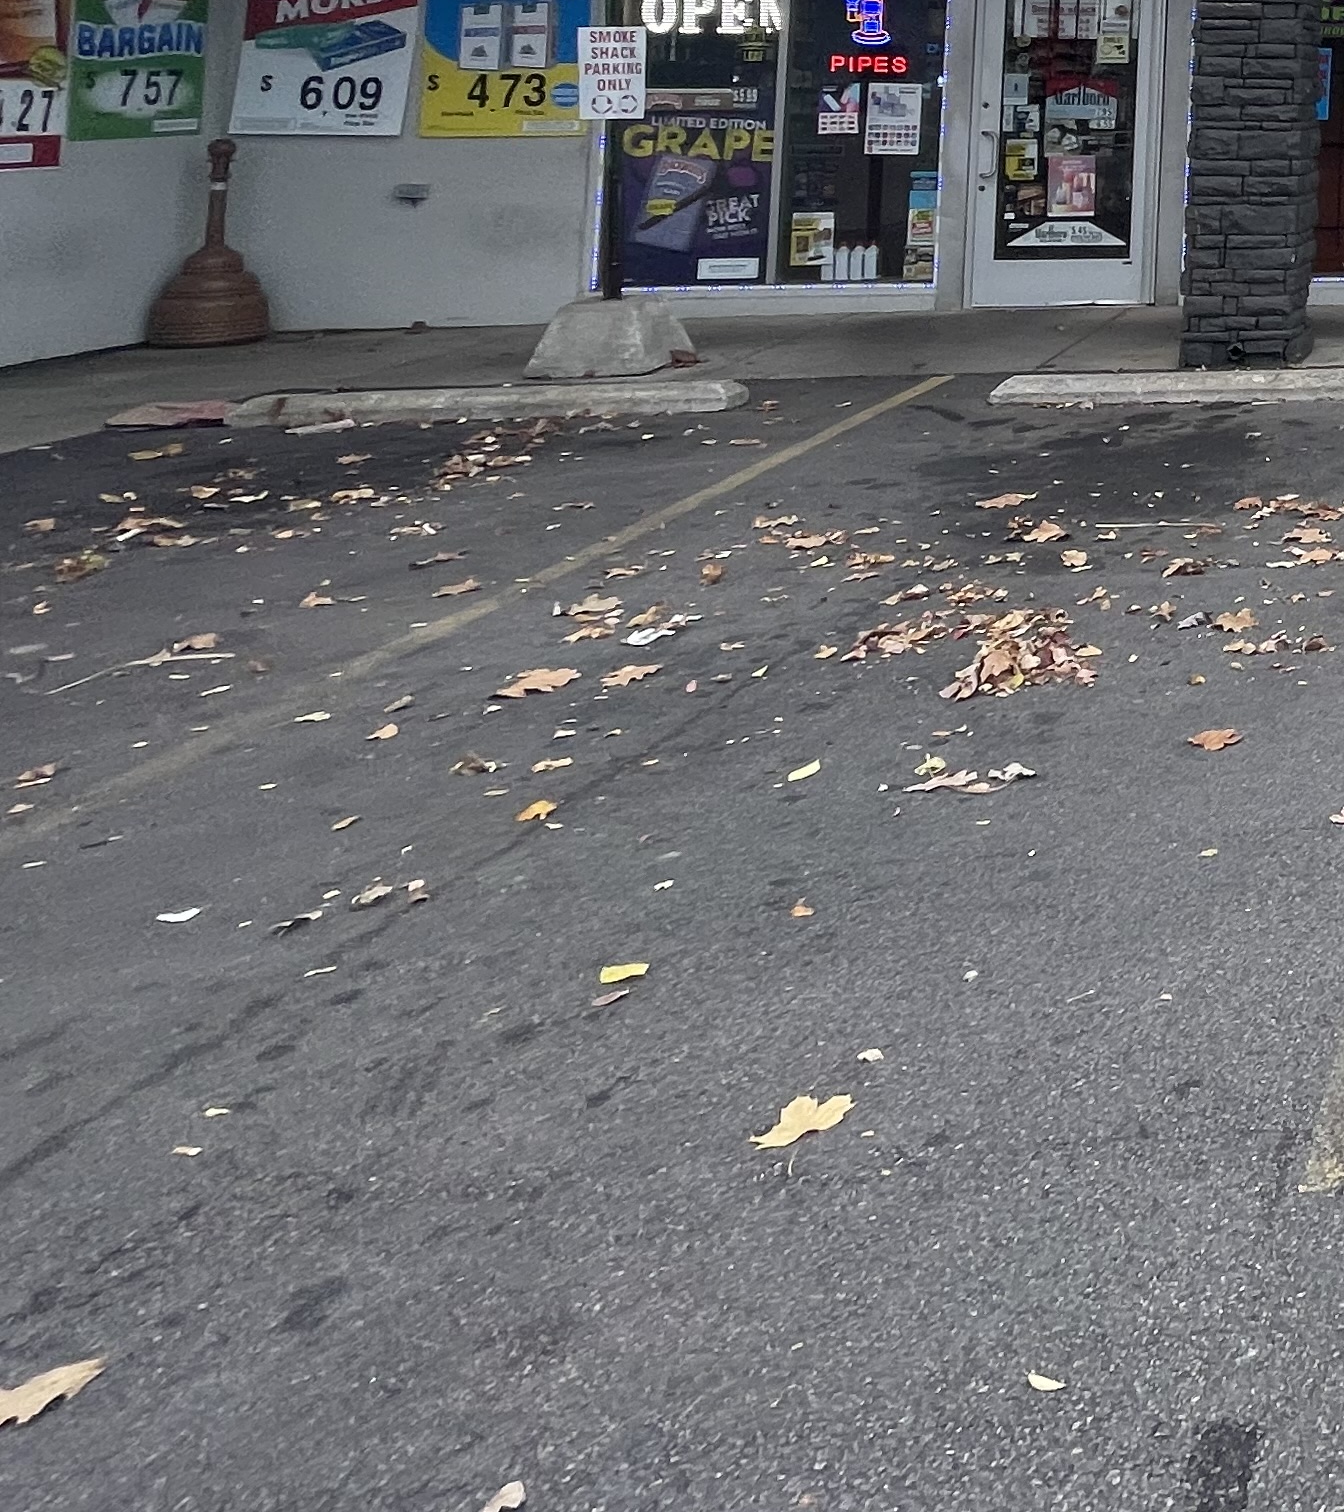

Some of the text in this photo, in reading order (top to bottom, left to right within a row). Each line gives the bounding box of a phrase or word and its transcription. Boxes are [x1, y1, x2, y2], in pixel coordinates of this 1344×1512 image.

[77, 22, 204, 58] BARGAIN
[589, 31, 637, 43] SMOKE
[591, 47, 637, 59] SHACK
[830, 55, 908, 73] PIPES
[584, 63, 642, 75] PARKING
[119, 69, 183, 109] 7.57
[300, 76, 383, 114] 6.09
[467, 73, 547, 111] 4.73
[597, 79, 632, 91] ONLY
[0, 89, 55, 132] .27
[652, 116, 767, 131] LIMITED EDITION
[623, 124, 775, 162] GRAPE
